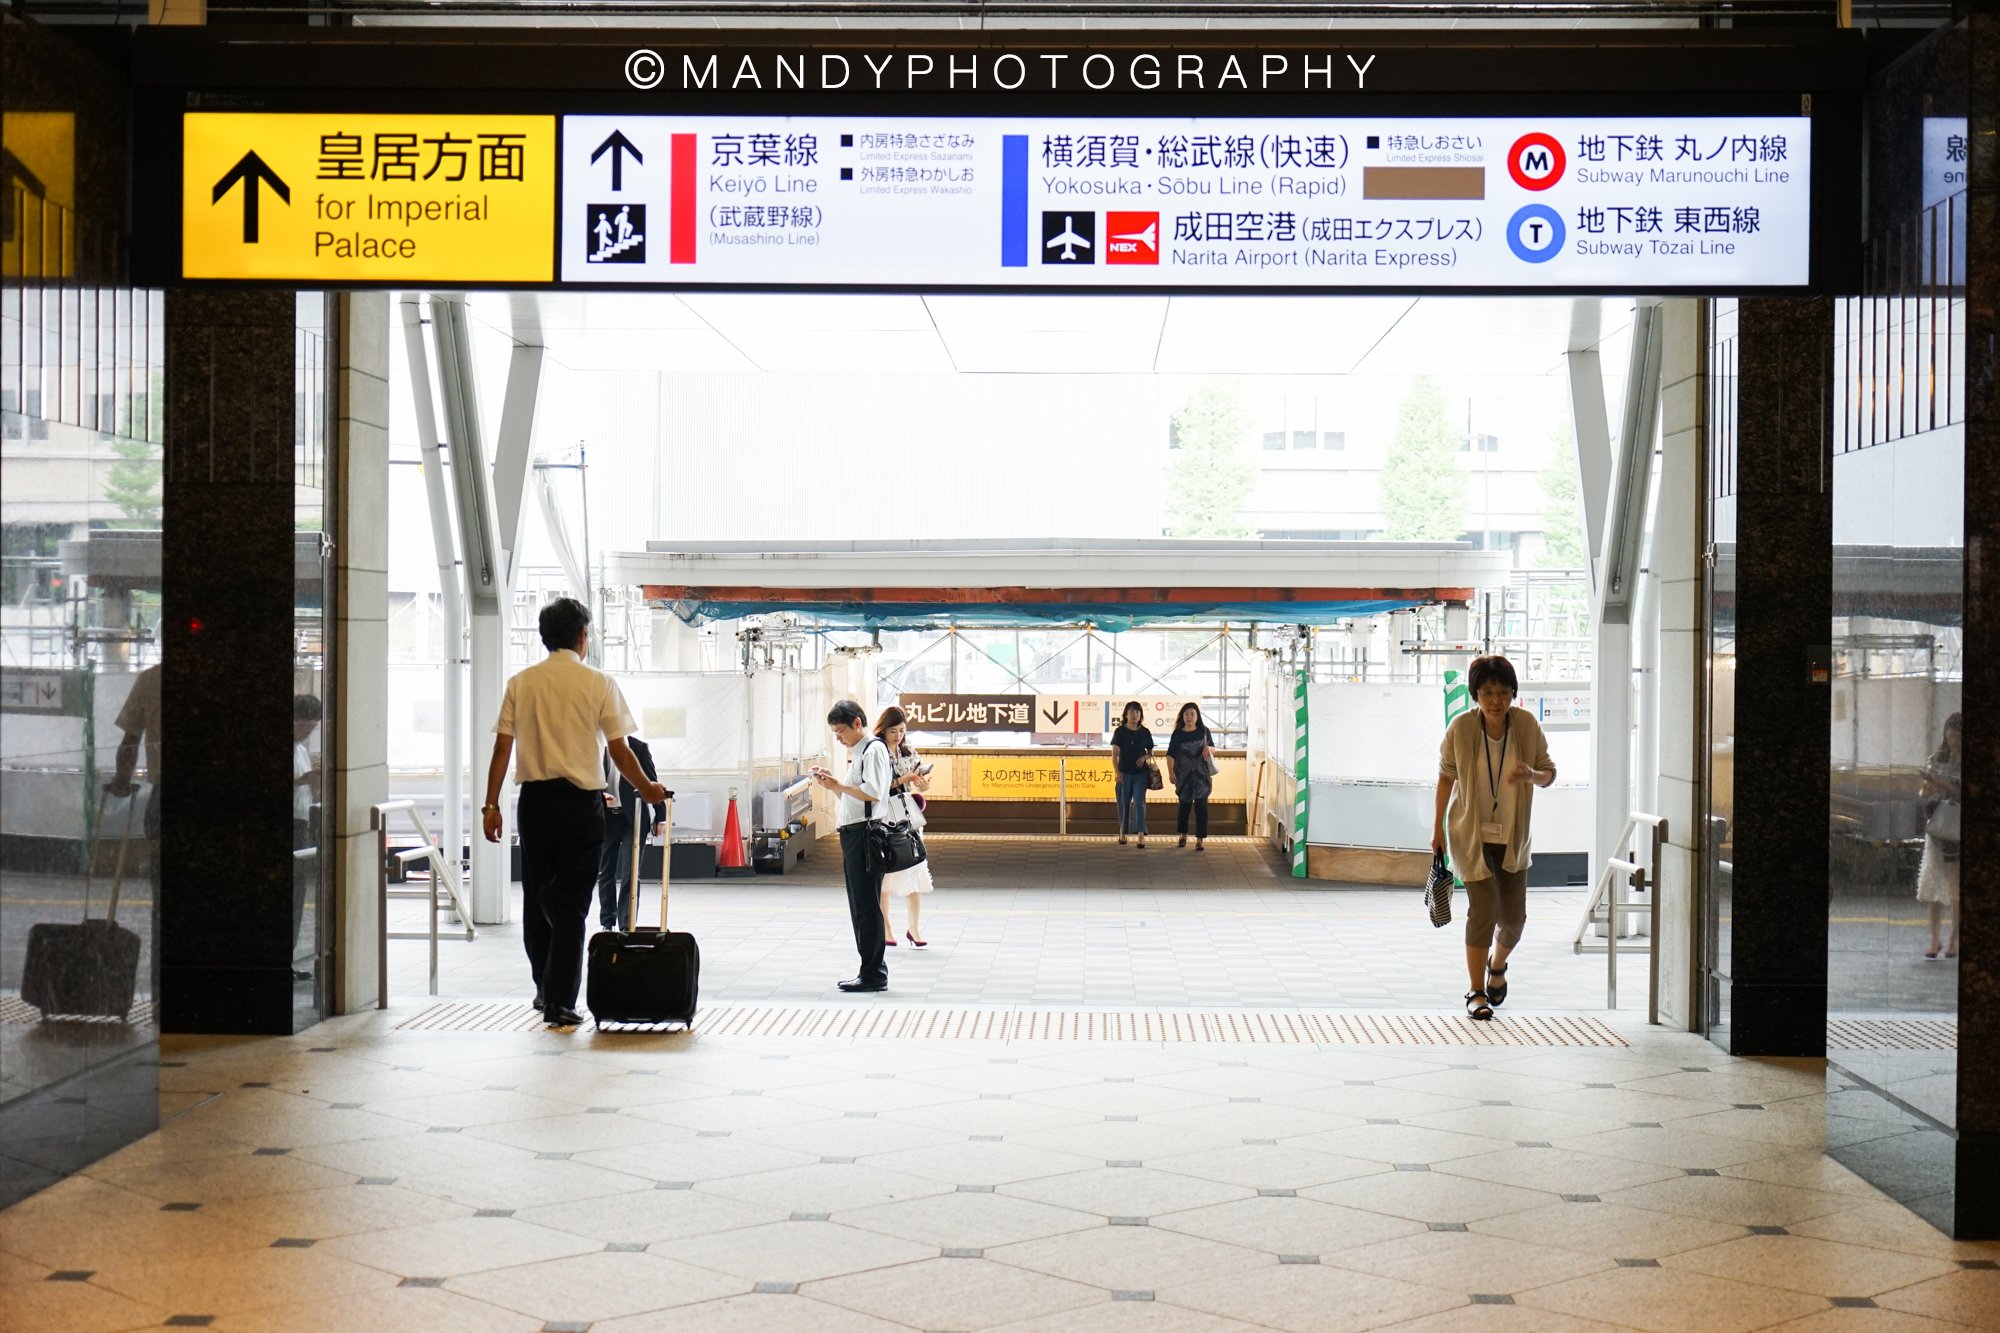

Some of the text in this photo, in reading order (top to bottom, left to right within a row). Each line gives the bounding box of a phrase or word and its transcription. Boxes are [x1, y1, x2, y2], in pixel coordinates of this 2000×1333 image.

[712, 133, 818, 166] 京葉線
[861, 134, 974, 148] 内房特急さざなみ
[1388, 135, 1481, 150] 特急しおさい
[1578, 134, 1787, 162] 地下鉄 丸ノ内線
[316, 131, 526, 182] 皇居方面
[861, 152, 972, 161] Limited Express Sazanami
[1387, 153, 1483, 163] Limited Express Shiosai
[1525, 151, 1549, 171] M
[861, 167, 974, 182] 外房特急わかしお
[1578, 168, 1789, 186] Subway Marunouchi Line
[710, 175, 817, 197] Keiyō Line
[860, 185, 972, 195] Limited Express Wakashio
[1220, 177, 1262, 194] Line
[1271, 175, 1345, 199] (Rapid)
[316, 194, 487, 226] for Imperial
[710, 205, 822, 228] (武蔵野線)
[1577, 206, 1760, 233] 地下鉄 東西線
[1174, 211, 1482, 241] 成田空港 (成田エクスプレス)
[1529, 223, 1543, 243] T
[315, 232, 415, 258] Palace
[710, 231, 819, 245] (Musashino Line)
[1173, 248, 1456, 269] Narita Airport (Narita Express)
[1577, 240, 1735, 258] Subway Tōzai Line
[905, 701, 1030, 725] 丸ビル地下道
[982, 769, 1118, 783] 丸の内地下南口改札方
